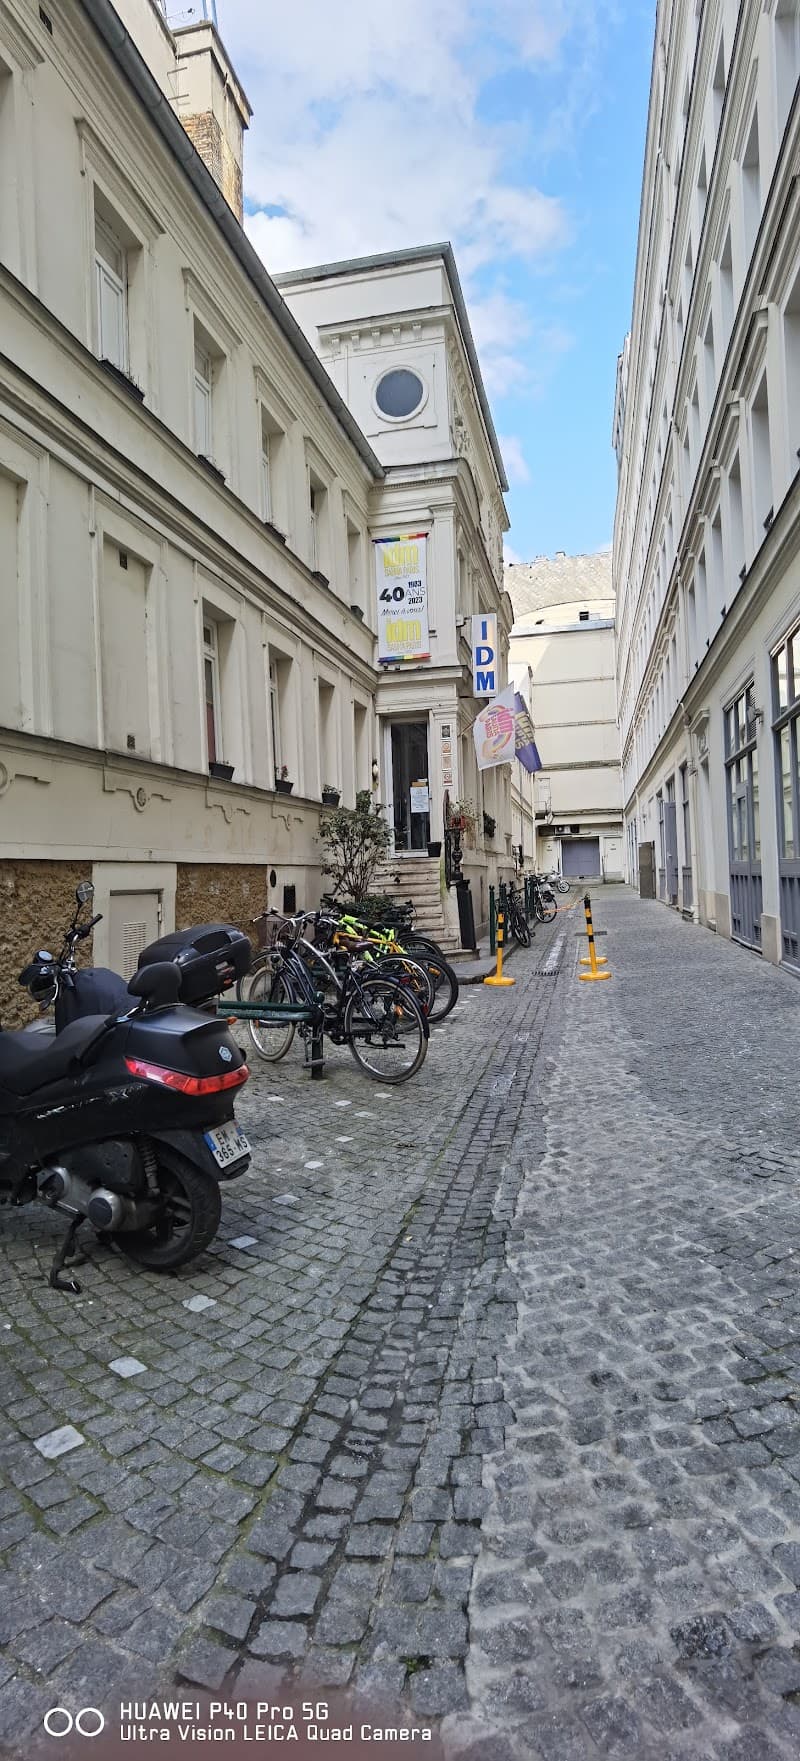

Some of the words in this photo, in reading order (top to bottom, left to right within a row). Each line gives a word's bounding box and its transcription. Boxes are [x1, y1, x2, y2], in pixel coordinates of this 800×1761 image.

[379, 586, 405, 602] 40
[405, 587, 426, 598] ANS
[408, 597, 423, 605] 2023
[475, 620, 495, 692] IDM
